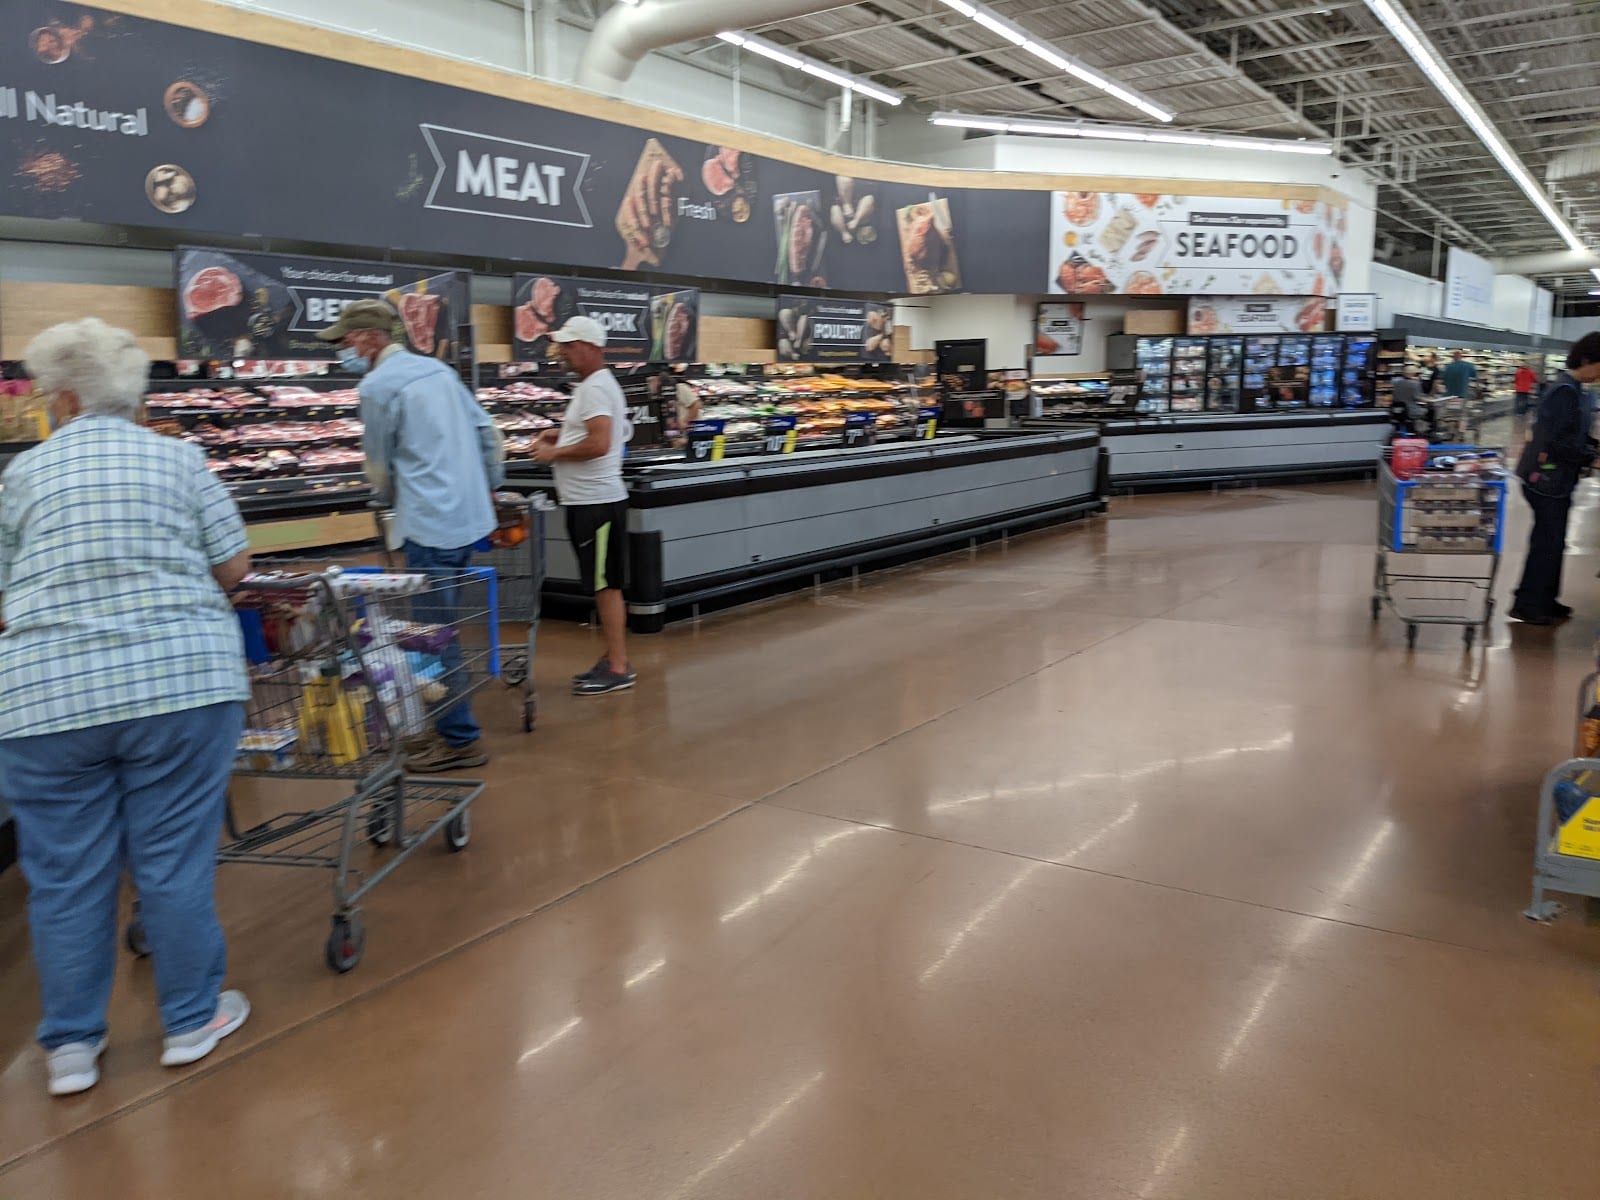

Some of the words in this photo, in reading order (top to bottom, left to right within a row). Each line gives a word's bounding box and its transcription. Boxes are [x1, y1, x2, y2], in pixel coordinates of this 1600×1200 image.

[25, 90, 148, 136] Natural
[456, 149, 565, 206] MEAT
[677, 197, 717, 220] Fresh
[1176, 232, 1298, 258] SEAFOOD
[306, 298, 354, 321] BE
[813, 322, 865, 340] POULTRY
